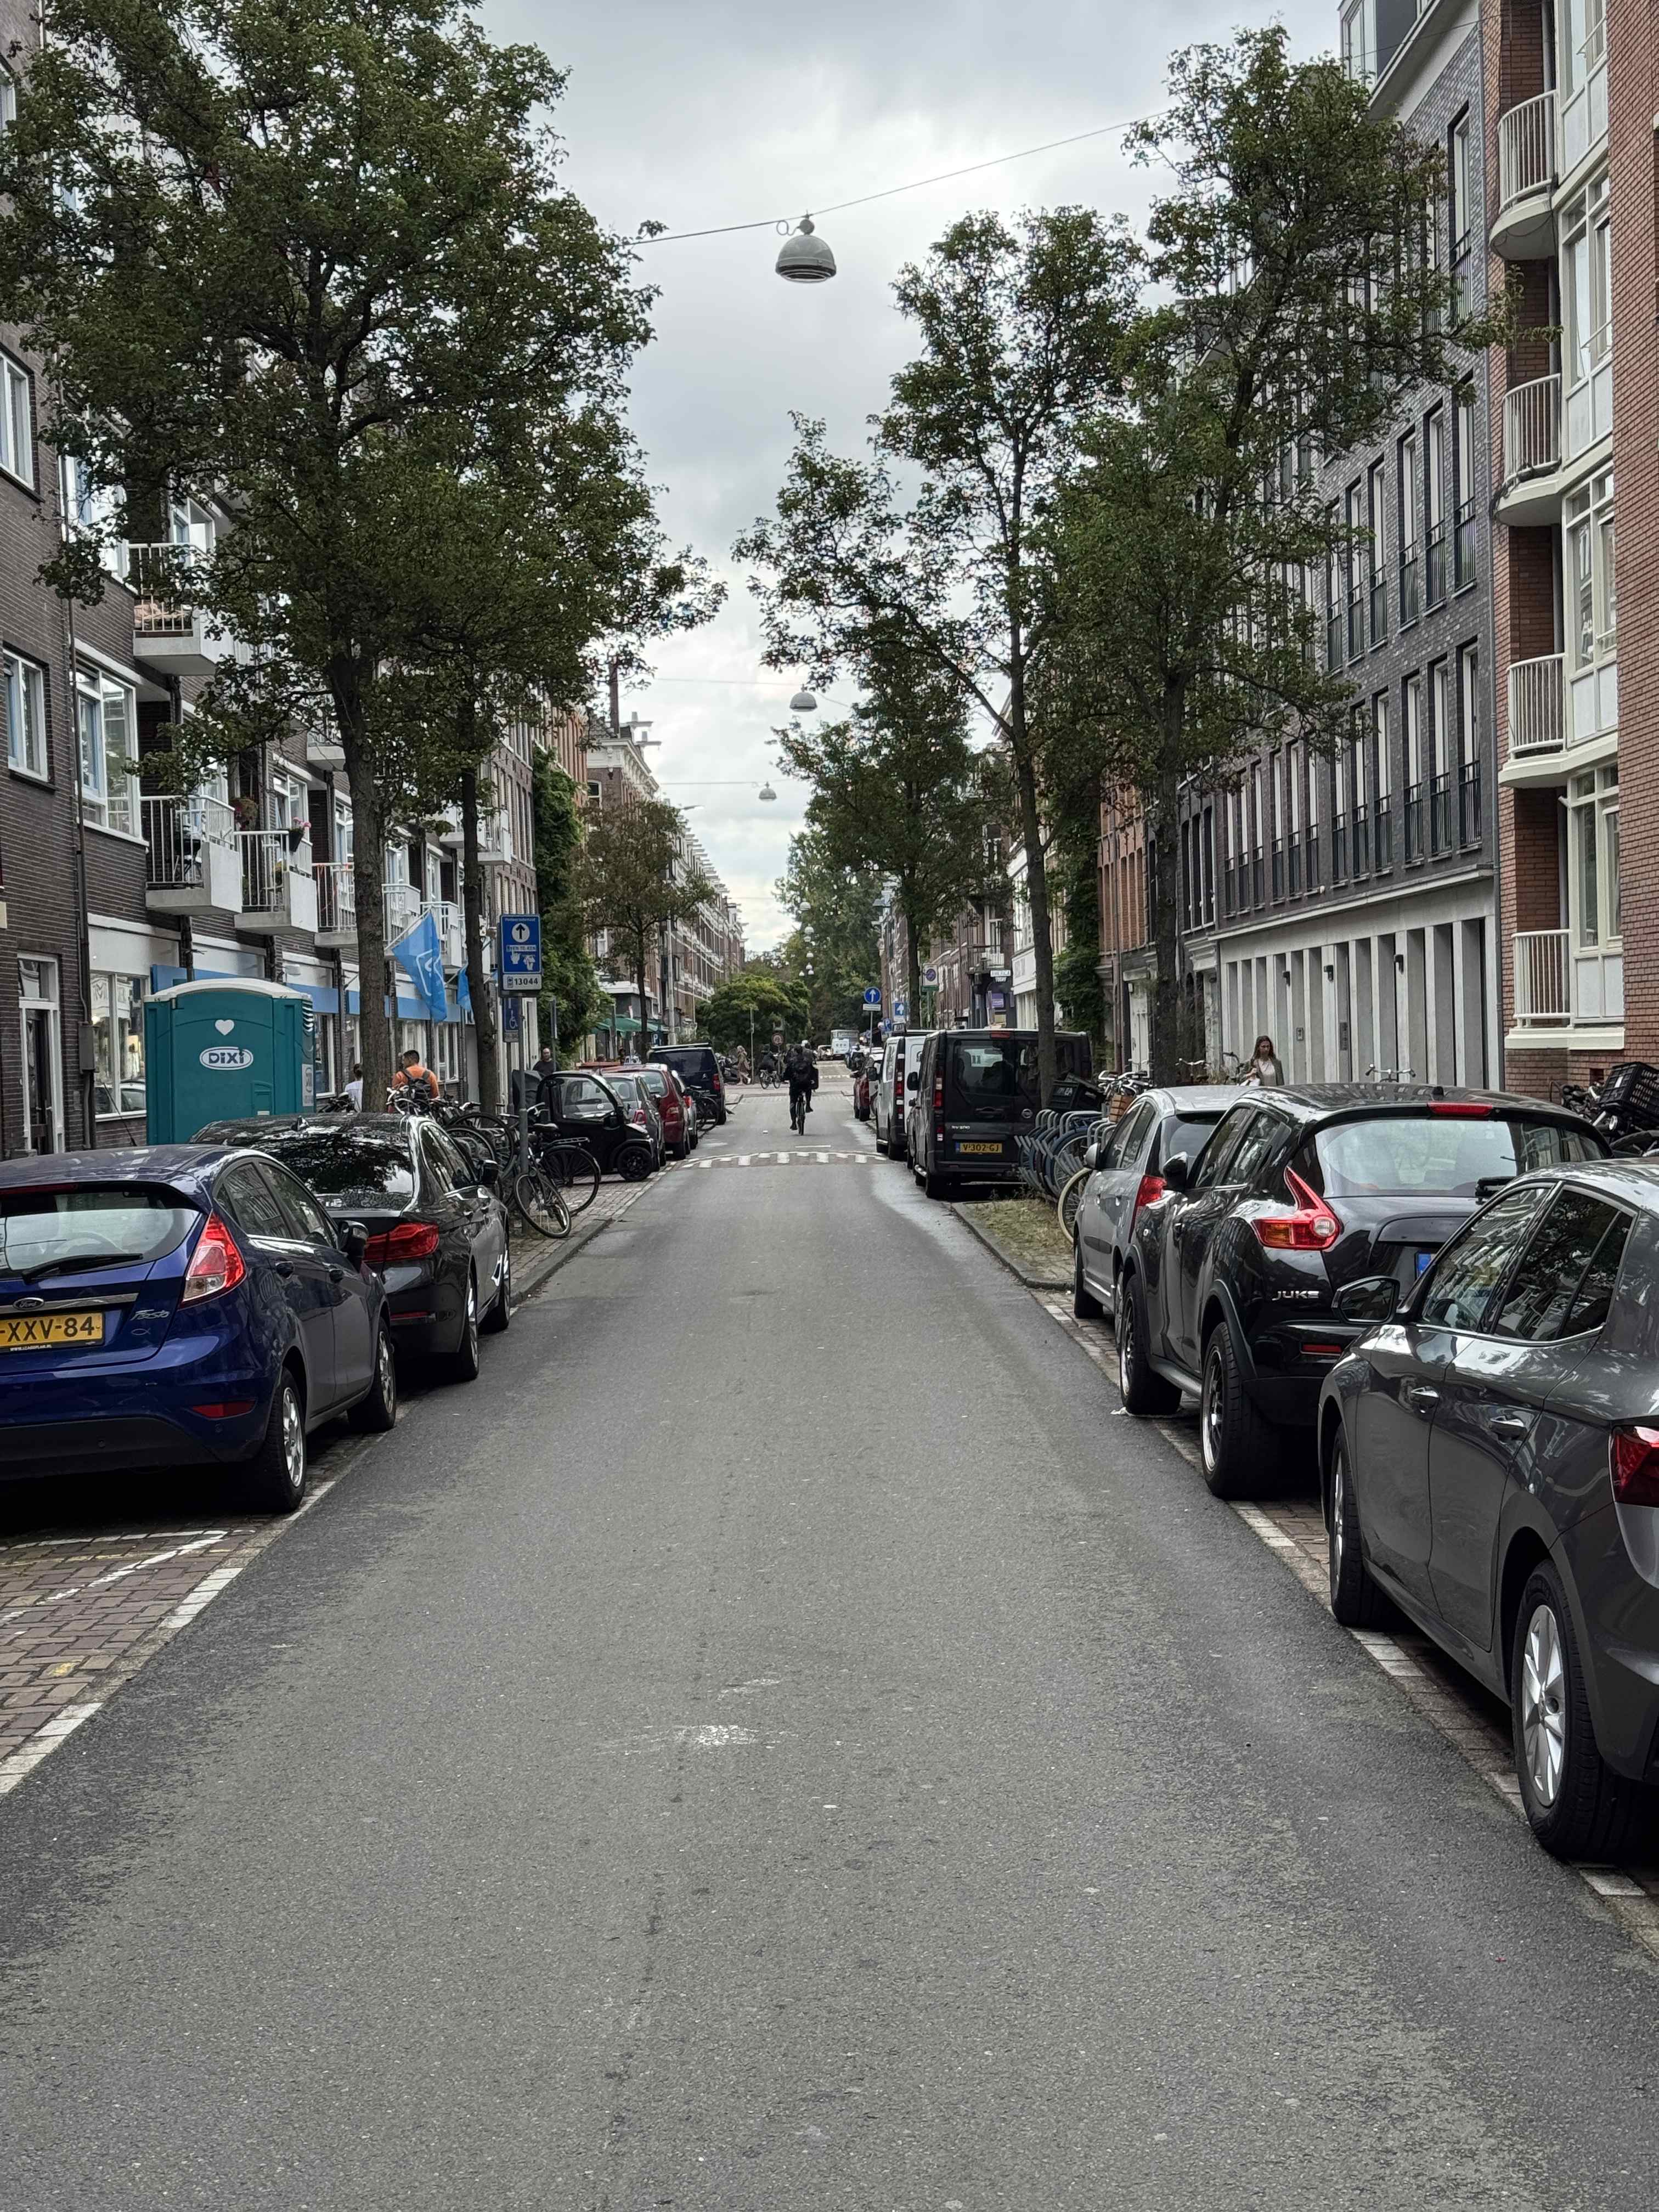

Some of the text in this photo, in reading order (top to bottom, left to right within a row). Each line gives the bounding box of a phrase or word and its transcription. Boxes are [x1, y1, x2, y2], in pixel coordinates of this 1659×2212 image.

[653, 1034, 658, 1043] P
[1272, 1291, 1319, 1301] JUKE
[130, 1309, 170, 1321] Fiesta
